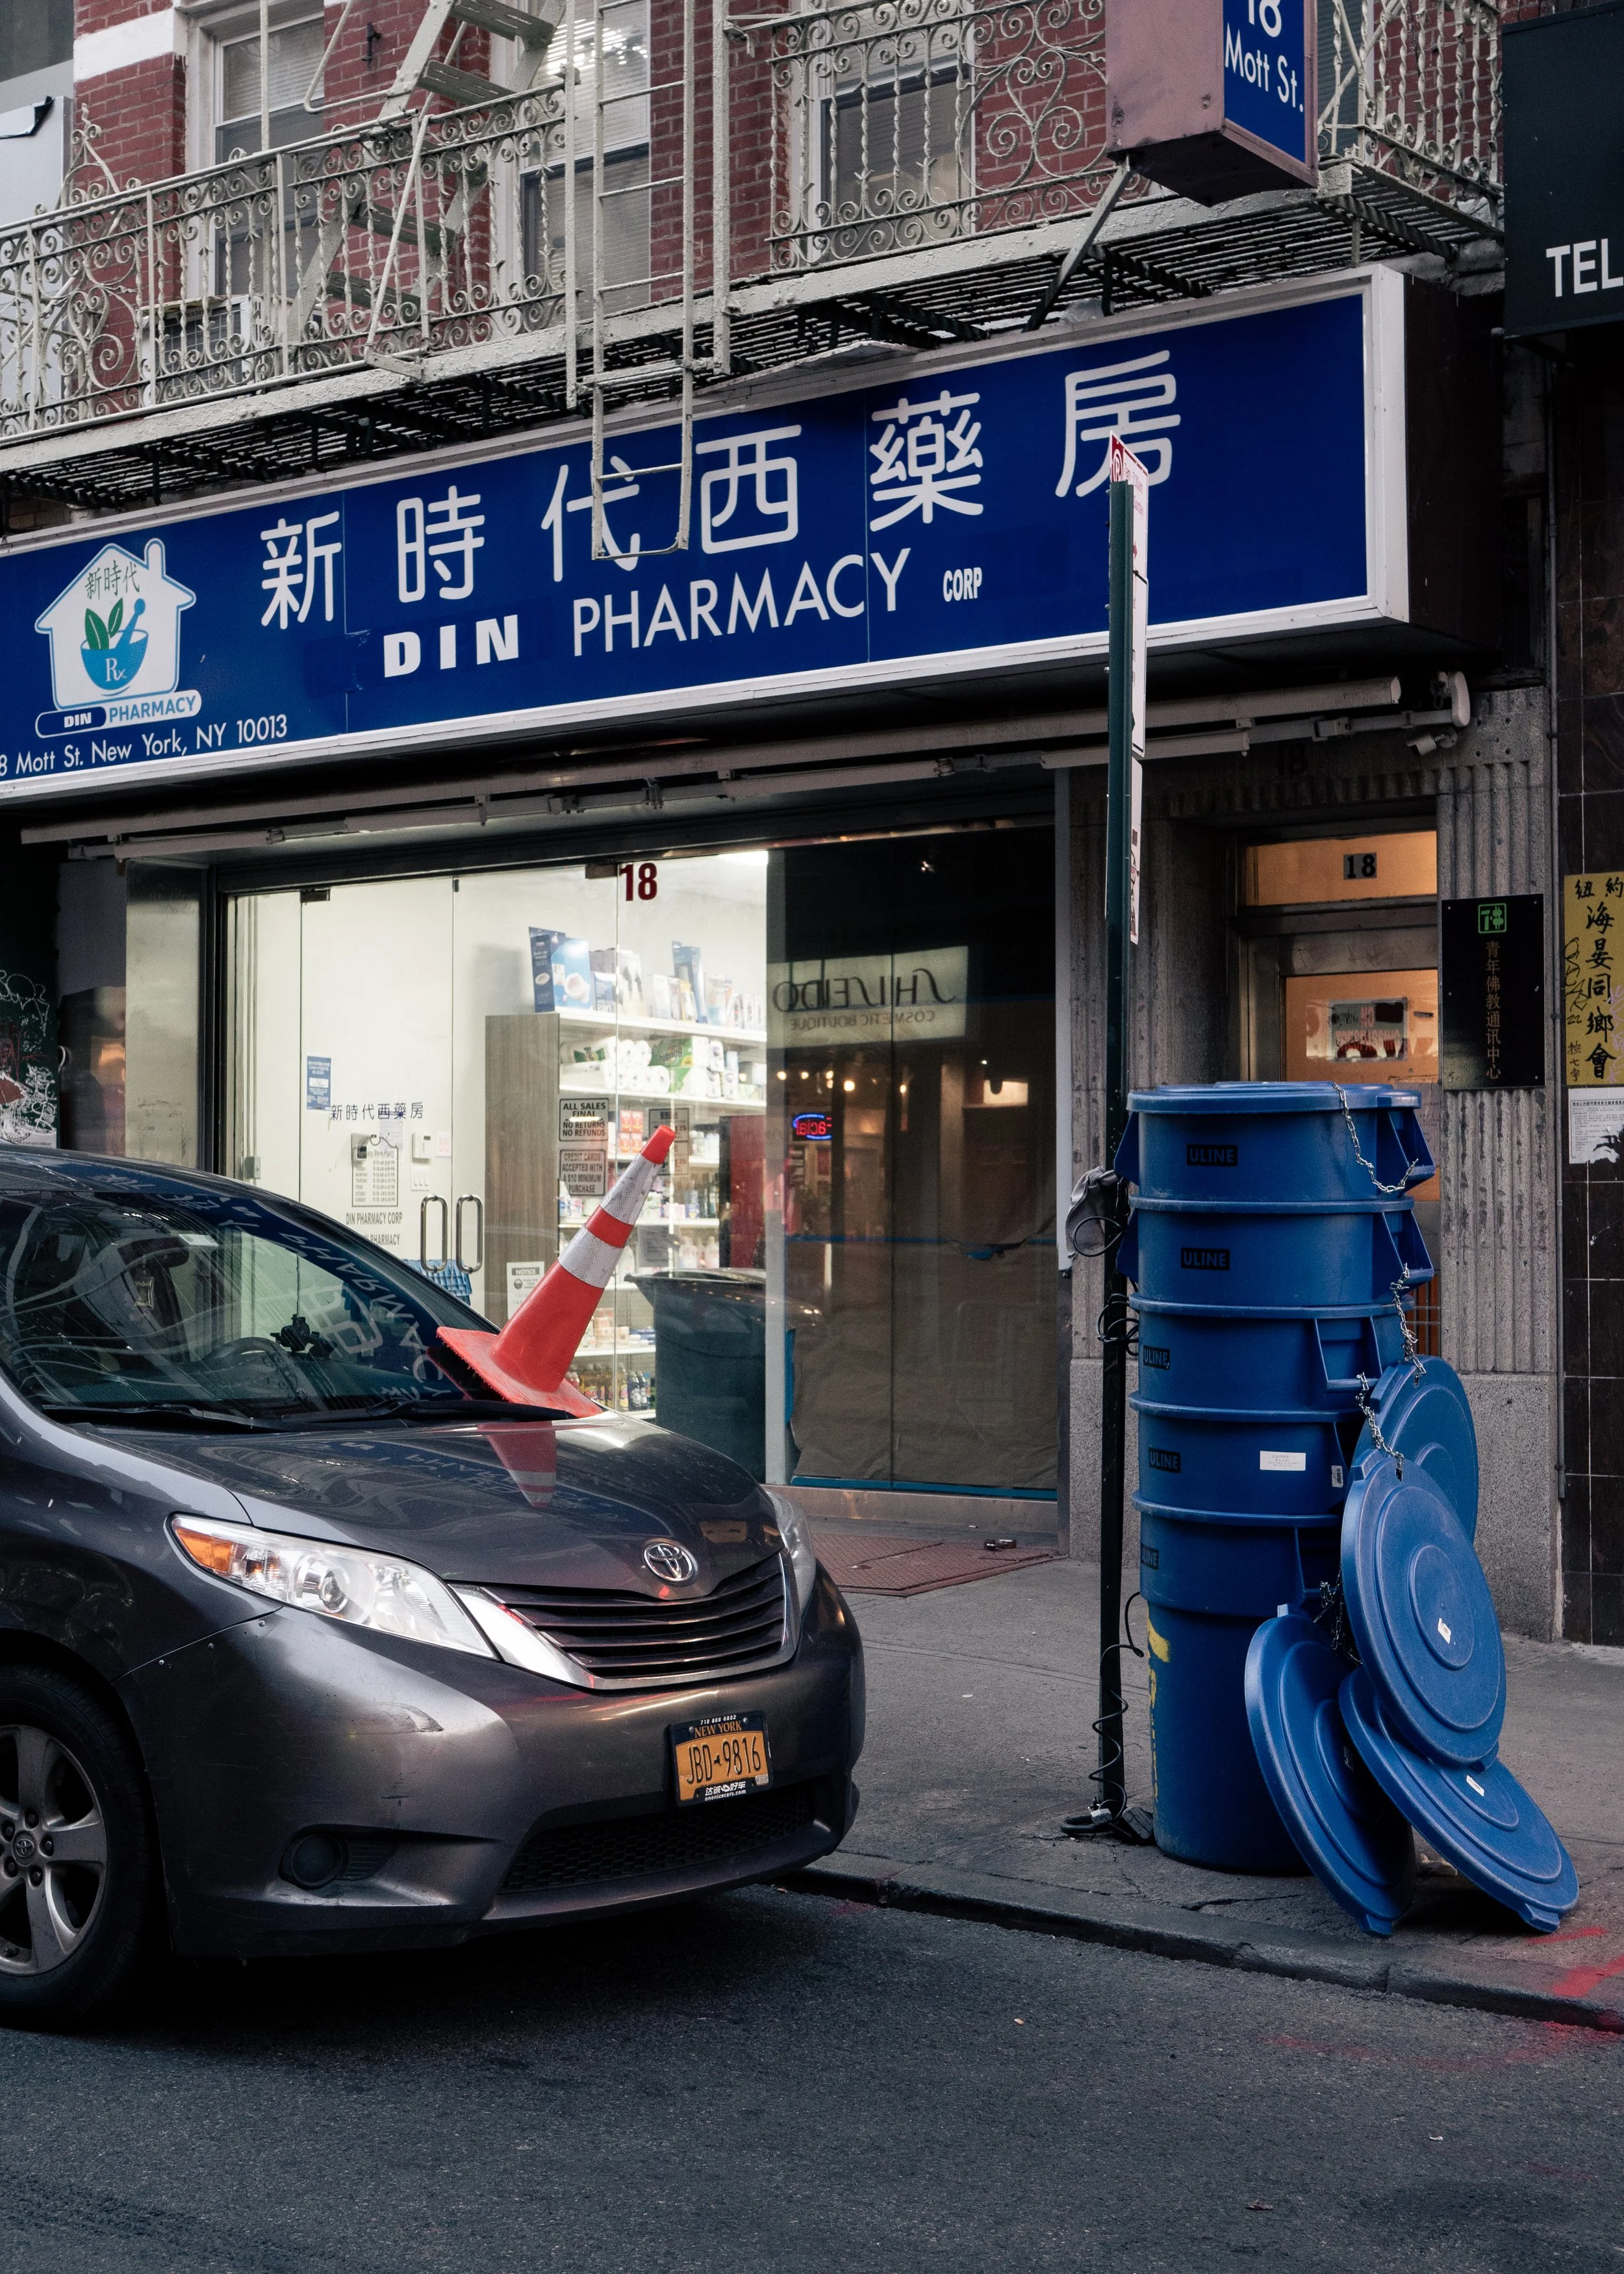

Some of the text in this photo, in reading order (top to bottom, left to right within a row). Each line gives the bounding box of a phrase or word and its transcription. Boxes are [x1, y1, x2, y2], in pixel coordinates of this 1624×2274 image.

[1225, 28, 1304, 113] Mott St.
[1545, 238, 1624, 298] TEL
[260, 350, 1181, 630] 新時代西藥房
[84, 559, 140, 600] 新時代
[383, 548, 983, 678] DIN PHARMACY CORP
[64, 695, 197, 728] DIN PHARMACY
[16, 750, 55, 774] Mott
[64, 743, 84, 767] St.
[91, 739, 132, 763] New
[141, 729, 187, 757] York,
[196, 722, 226, 749] NY
[237, 713, 288, 742] 10013
[1347, 854, 1376, 878] 18
[619, 862, 657, 901] 18
[1575, 876, 1624, 899] 紐約
[330, 1102, 424, 1121] 新時代西藥房
[1189, 1147, 1235, 1164] ULINE
[562, 1164, 603, 1172] ACCEPTED WITH
[568, 1184, 595, 1193] PURCHASE
[346, 1211, 403, 1225] DIN PHARMACY CORP
[371, 1234, 400, 1246] PHARMACY
[1183, 1251, 1227, 1268] ULINE
[1143, 1349, 1169, 1366] ULINE
[1150, 1453, 1178, 1470] ULINE
[694, 1721, 742, 1739] NEW YORK
[704, 1789, 746, 1802] onenicecars.com
